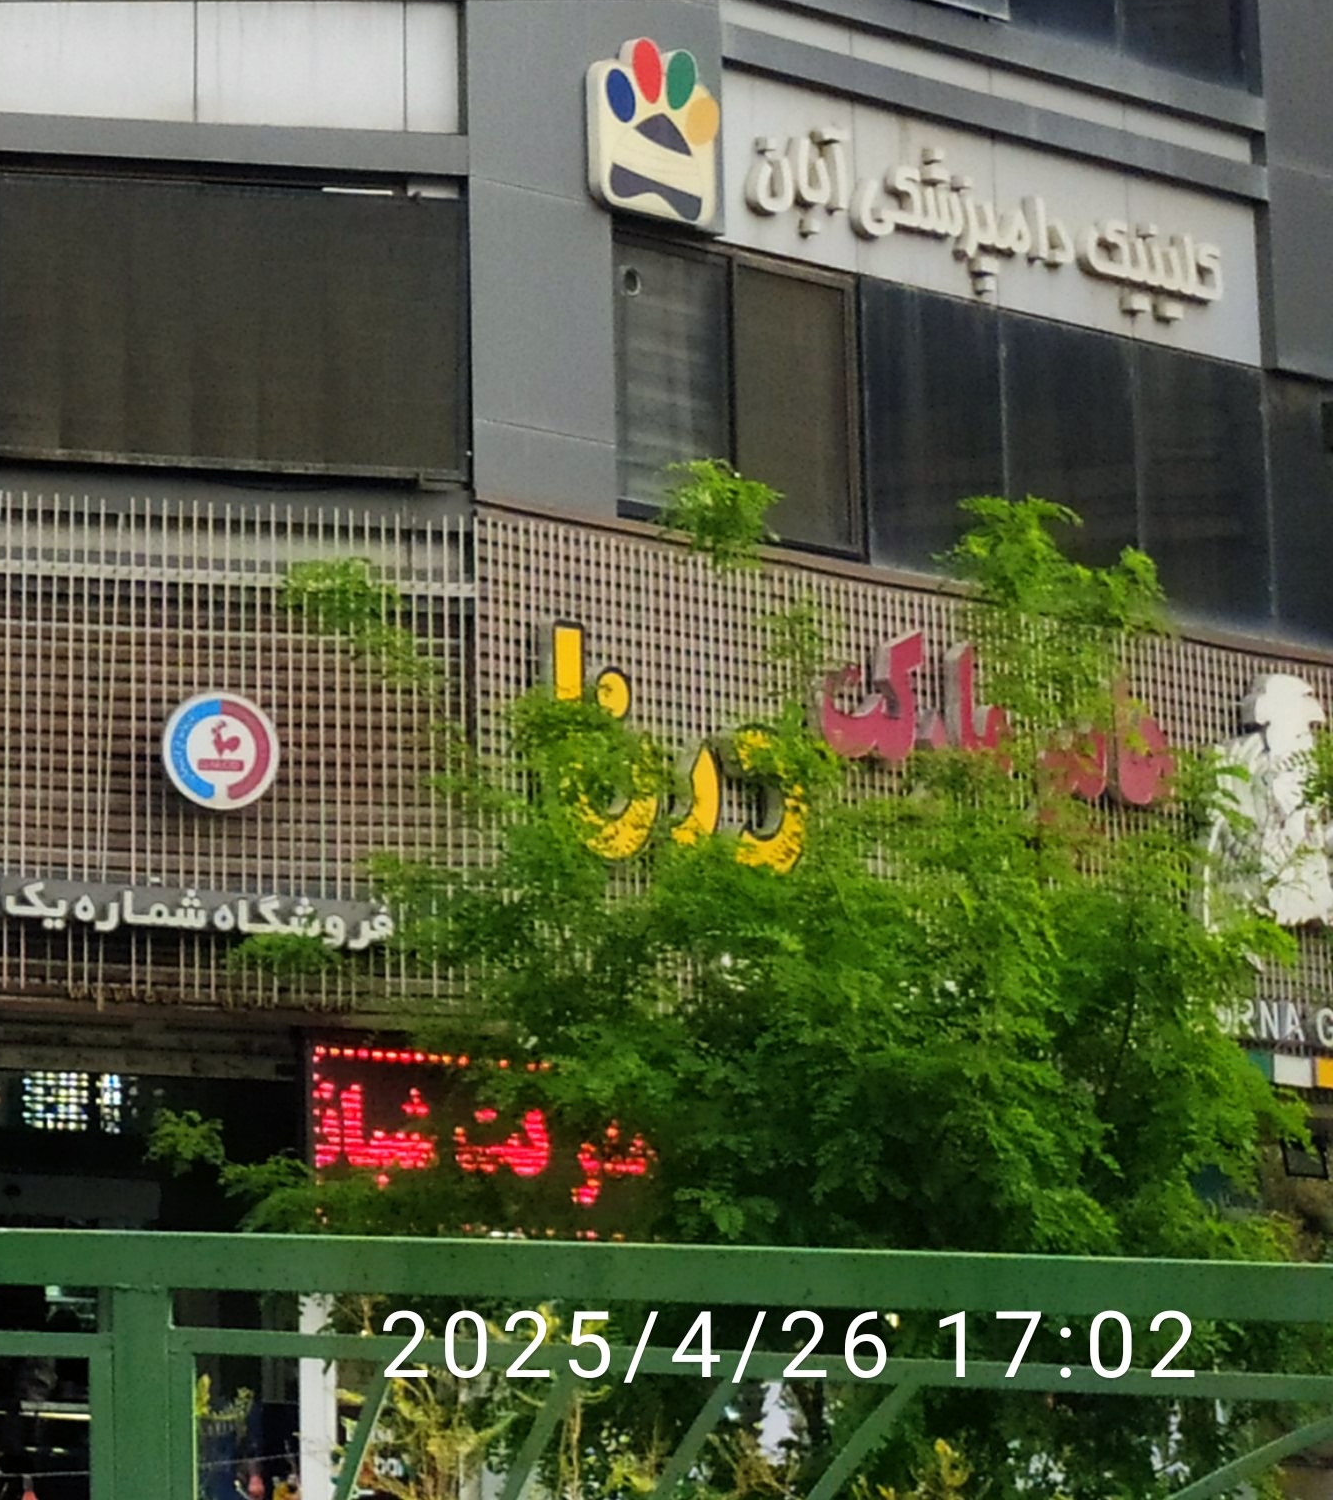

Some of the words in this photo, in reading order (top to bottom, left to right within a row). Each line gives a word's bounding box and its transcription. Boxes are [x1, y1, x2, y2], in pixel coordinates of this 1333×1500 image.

[744, 127, 850, 238] آبان
[848, 147, 1075, 299] دامپزشکی
[1074, 217, 1225, 325] کلینیک
[4, 881, 68, 930] یک
[73, 887, 208, 933] شماره
[212, 892, 396, 951] فروشگاه
